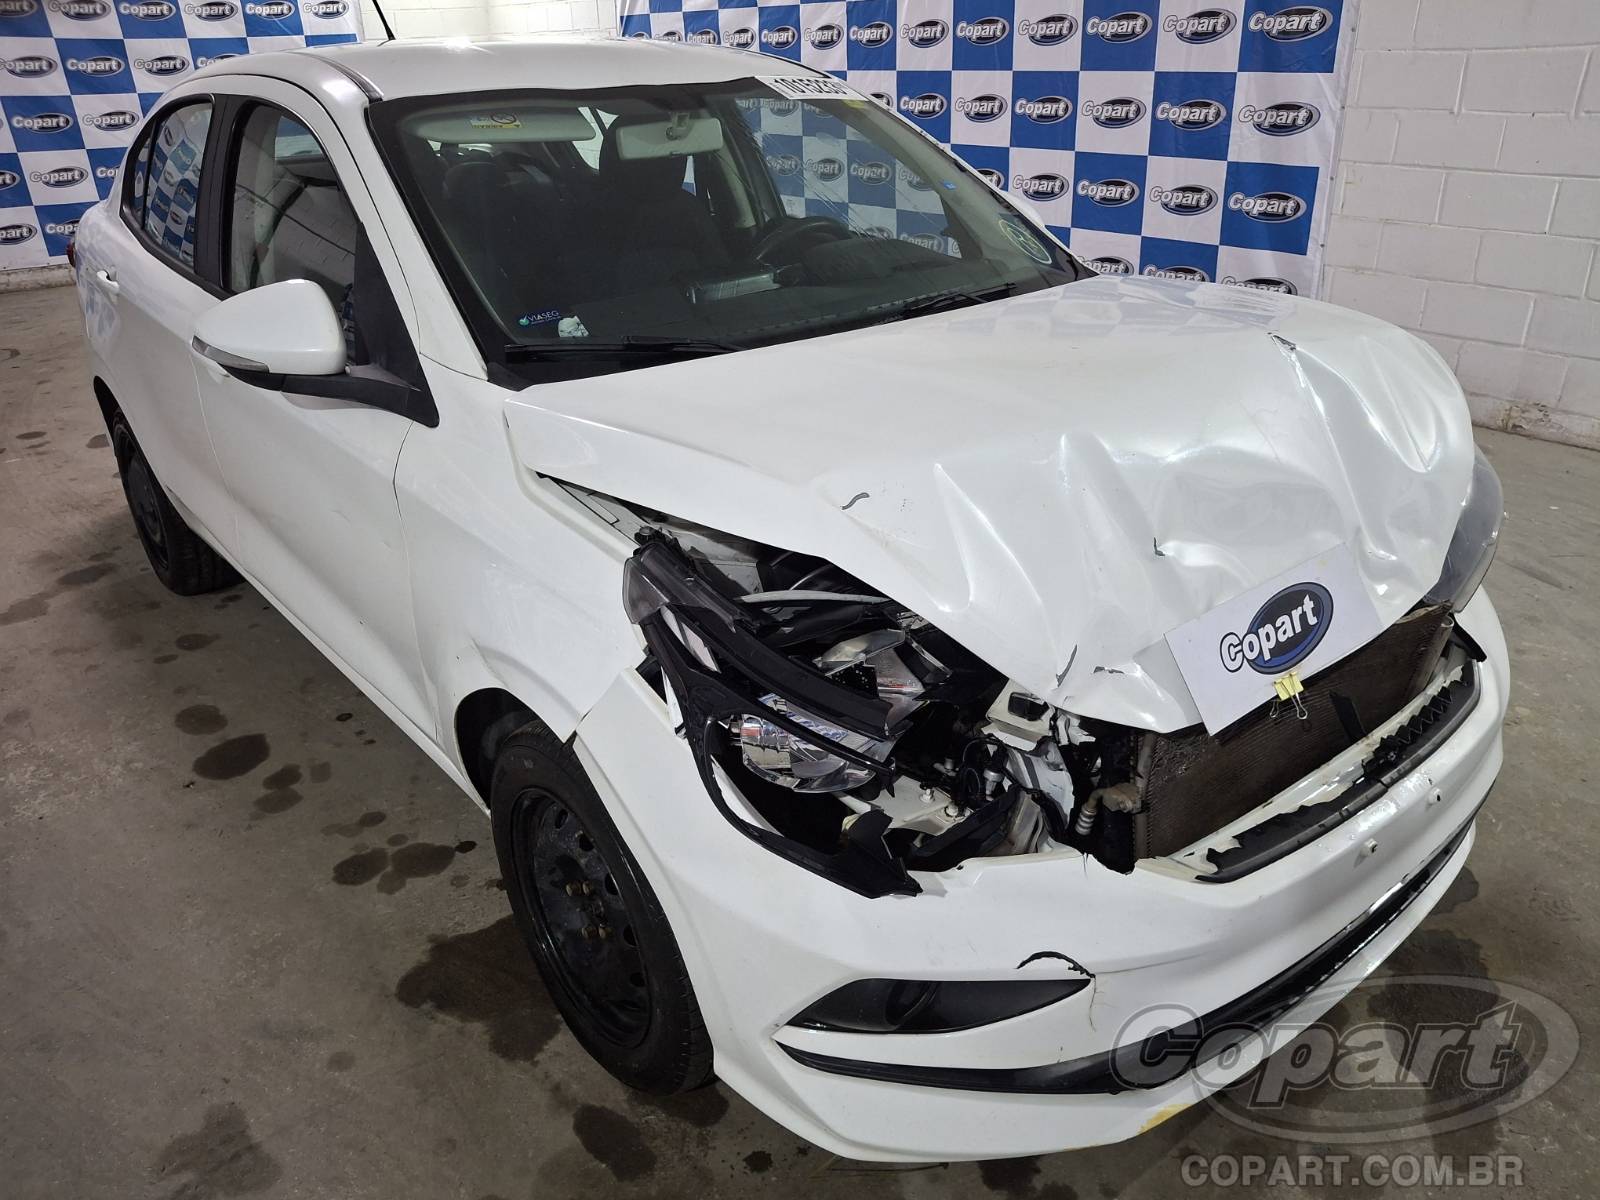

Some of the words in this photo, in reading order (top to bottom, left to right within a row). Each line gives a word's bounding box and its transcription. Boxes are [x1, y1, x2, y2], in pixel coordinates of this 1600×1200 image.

[0, 1, 29, 13] part
[51, 1, 102, 16] Copart
[119, 3, 170, 16] Copart
[185, 3, 231, 16] Copart
[246, 3, 290, 16] Copart
[304, 3, 344, 15] Copart
[1018, 18, 1070, 39] Copart
[1086, 16, 1145, 38] Copart
[1163, 13, 1227, 37] Copart
[1248, 8, 1323, 36] Copart
[687, 33, 714, 43] Copart
[723, 31, 752, 45] Copart
[761, 29, 793, 43] Copart
[804, 27, 838, 42] Copart
[851, 25, 888, 43] Copart
[900, 23, 942, 42] Copart
[956, 21, 1003, 41] Copart
[67, 59, 118, 73] Copart
[135, 59, 181, 73] Copart
[900, 96, 942, 112] Copart
[955, 97, 1001, 115] Copart
[1015, 97, 1067, 118] Copart
[1082, 100, 1138, 120] Copart
[83, 114, 132, 128] Copart
[1156, 101, 1218, 125] Copart
[1238, 104, 1309, 129] Copart
[13, 115, 67, 129] Copart
[766, 155, 796, 169] Copart
[805, 158, 840, 174] Copart
[850, 161, 887, 179] Copart
[30, 169, 81, 183] Copart
[1013, 174, 1062, 194] Copart
[1077, 179, 1132, 201] Copart
[1150, 186, 1209, 208] Copart
[1228, 191, 1297, 217] Copart
[0, 226, 29, 239] part
[46, 223, 80, 235] Copa
[1220, 594, 1318, 673] Copart
